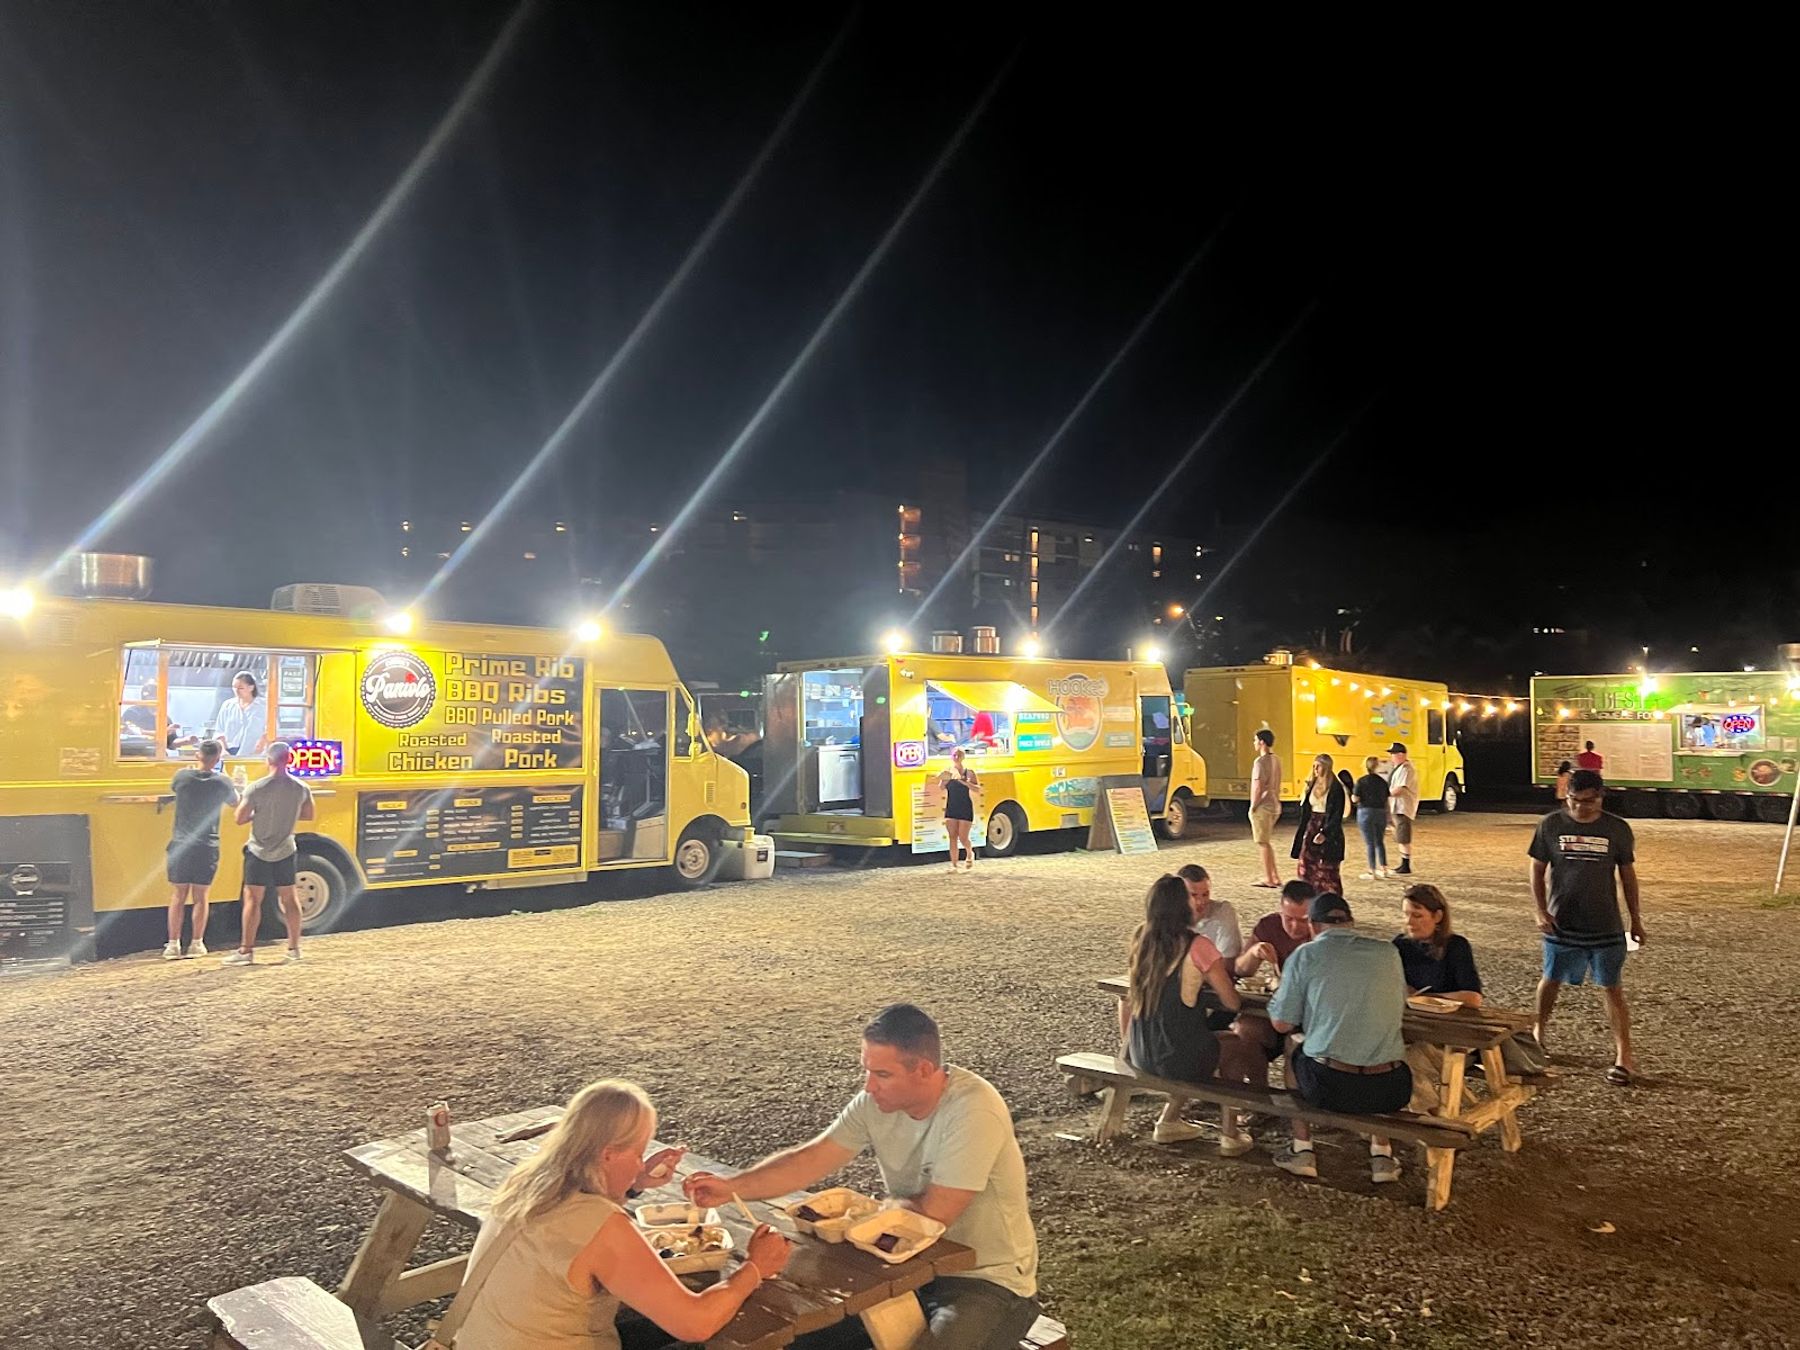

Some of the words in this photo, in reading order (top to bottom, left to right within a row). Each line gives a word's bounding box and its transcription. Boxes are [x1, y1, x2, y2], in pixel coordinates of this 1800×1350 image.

[445, 652, 526, 676] Prime
[535, 656, 575, 679] Rib
[446, 680, 499, 704] BBQ
[508, 682, 566, 704] Ribs
[445, 706, 477, 726] BBQ
[482, 707, 532, 726] Pulled
[536, 710, 574, 726] Pork
[1724, 719, 1751, 731] OPEN
[399, 733, 467, 747] Roasted
[491, 729, 561, 744] Roasted
[388, 752, 473, 771] Chicken
[504, 749, 557, 769] Pork
